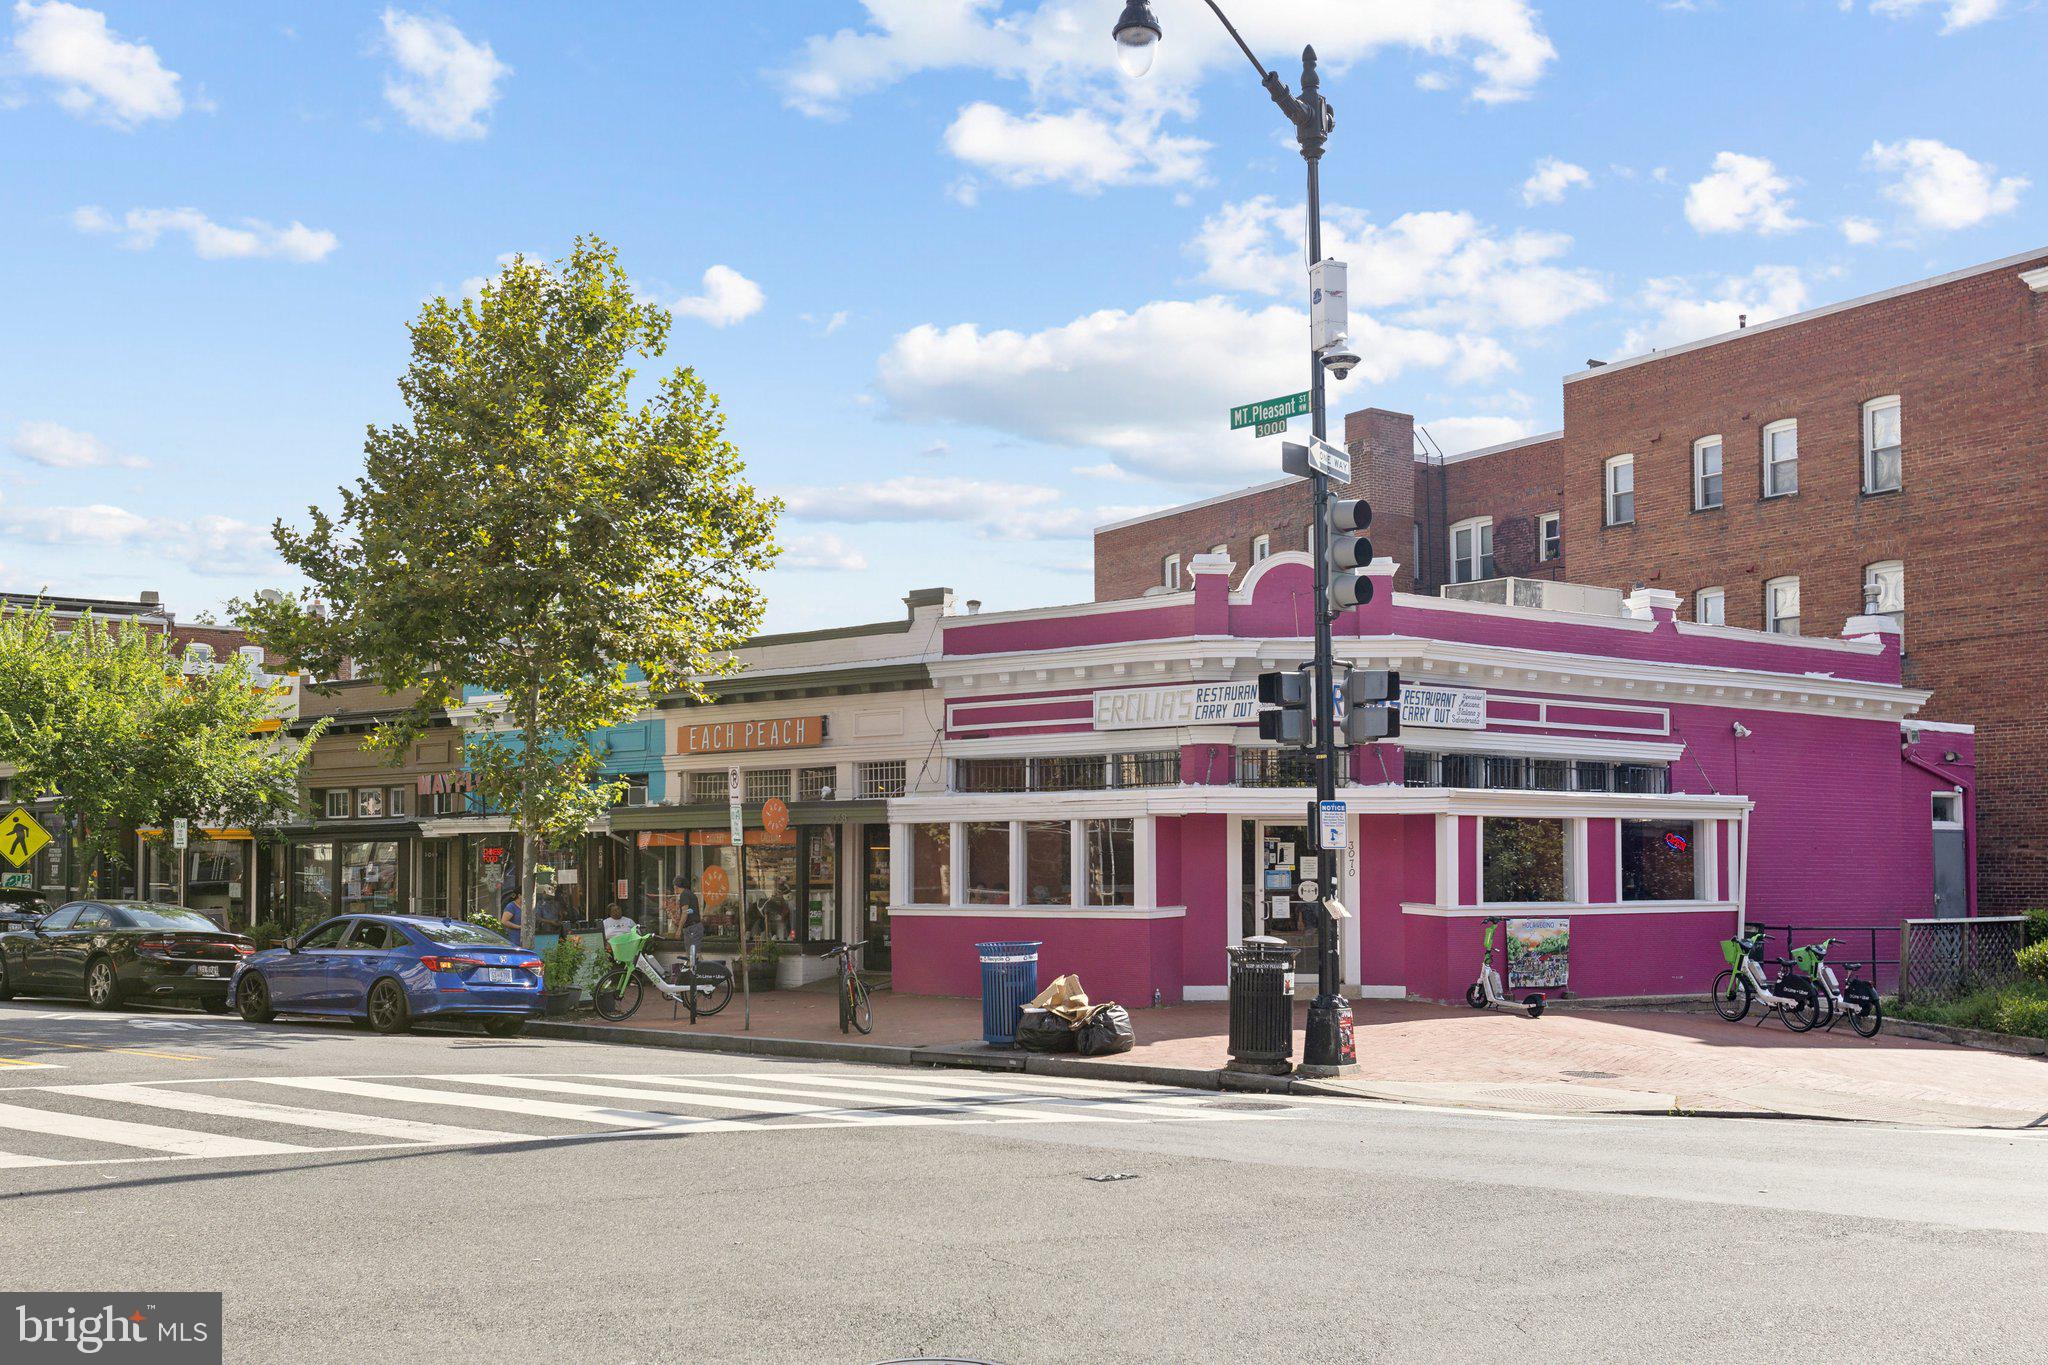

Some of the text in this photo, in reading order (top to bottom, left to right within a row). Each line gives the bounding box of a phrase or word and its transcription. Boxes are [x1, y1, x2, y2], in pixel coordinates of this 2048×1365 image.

[1252, 397, 1296, 421] Pleasant
[1257, 420, 1286, 437] 3000
[1333, 455, 1348, 472] WAY
[1196, 684, 1258, 703] RESTAURAN
[1404, 689, 1457, 709] RESTAURANT
[1194, 704, 1227, 720] CARRY
[1232, 701, 1253, 718] OUT
[1402, 705, 1450, 724] CARRY OUT
[689, 719, 806, 750] EACH PEACH
